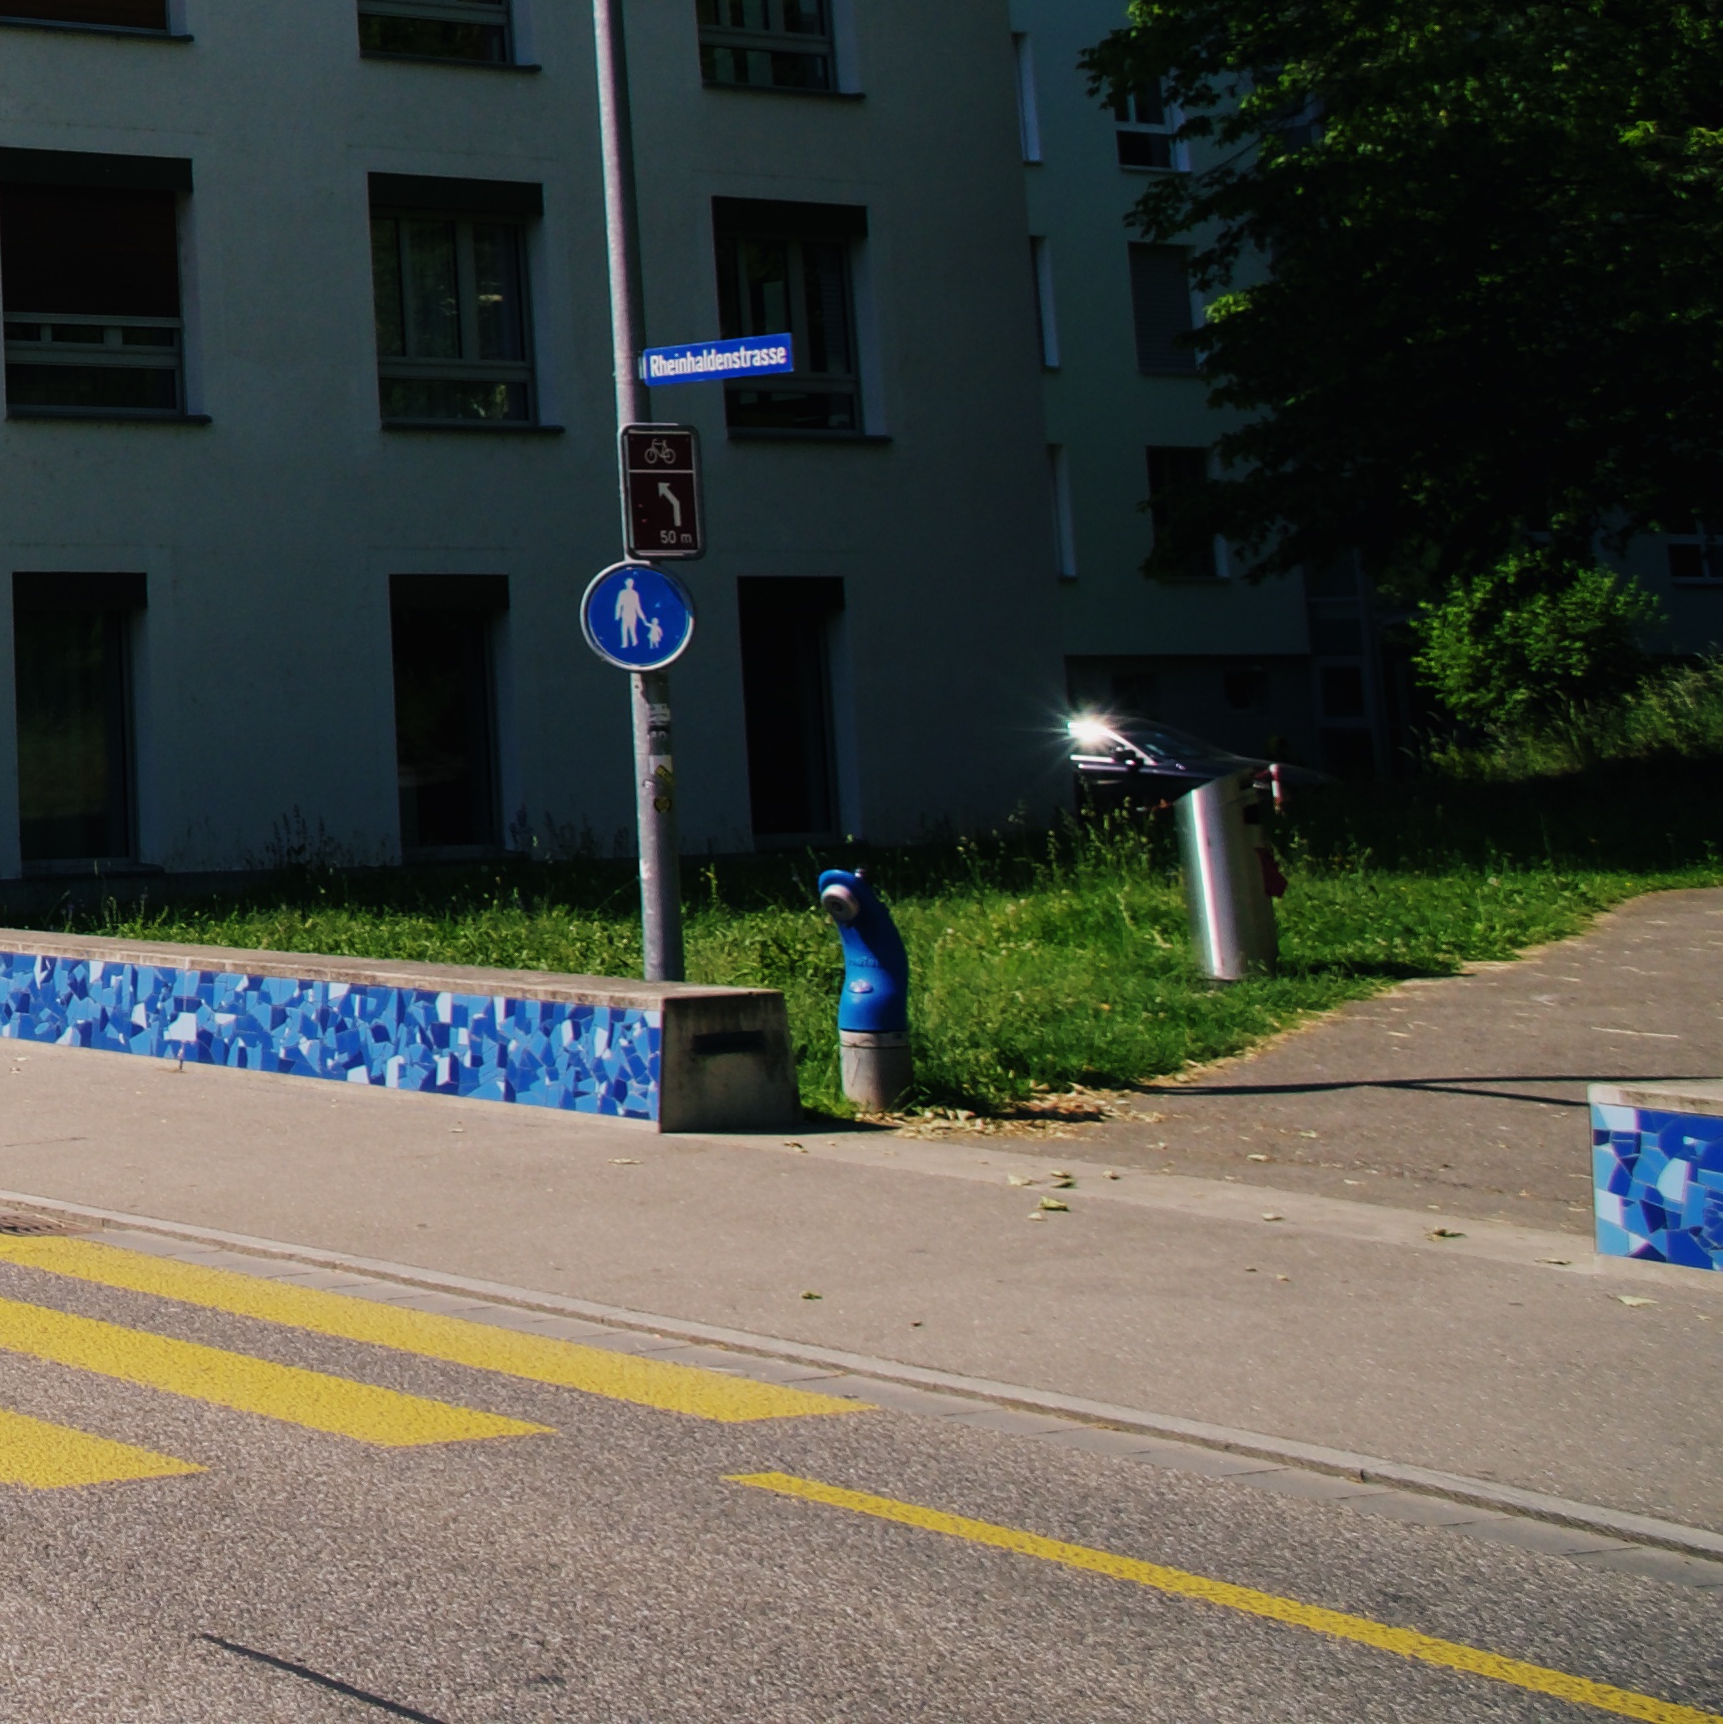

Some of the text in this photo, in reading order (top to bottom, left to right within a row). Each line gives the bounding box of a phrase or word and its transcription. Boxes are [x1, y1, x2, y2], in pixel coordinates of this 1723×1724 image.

[649, 346, 787, 377] Rheinhaldenstrasse
[660, 530, 692, 544] 50 m
